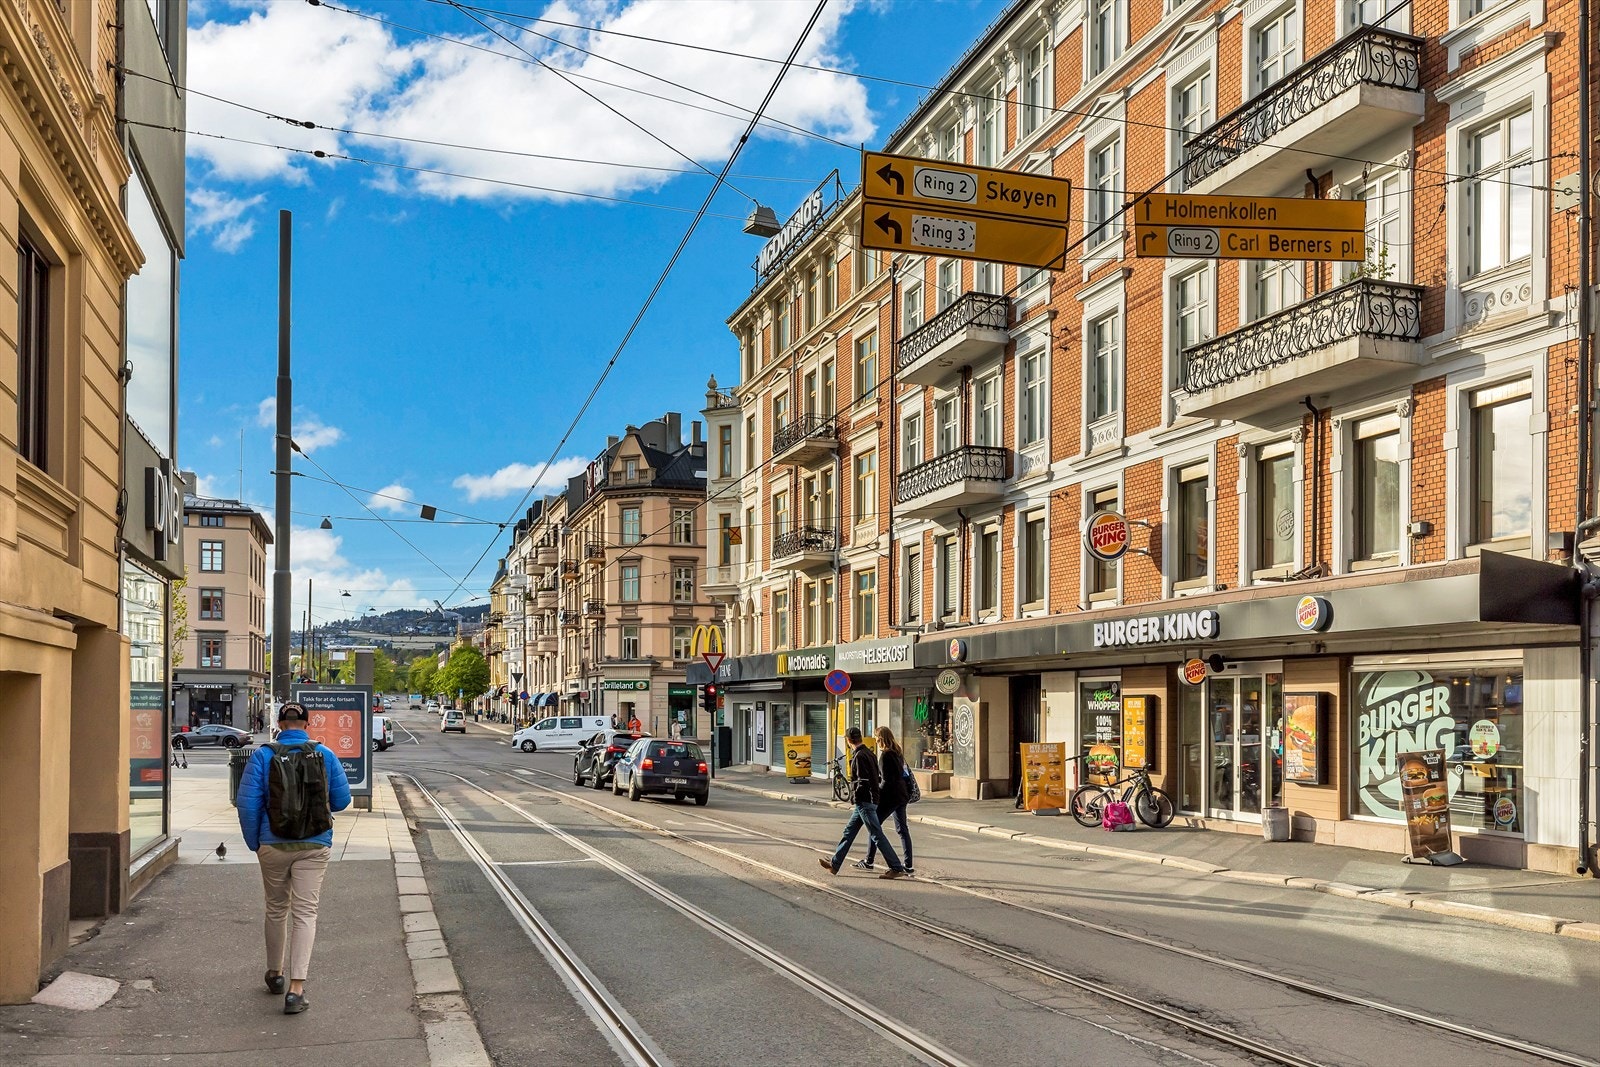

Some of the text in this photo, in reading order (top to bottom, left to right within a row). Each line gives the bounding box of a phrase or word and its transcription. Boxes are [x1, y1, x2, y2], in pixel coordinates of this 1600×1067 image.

[923, 175, 1057, 209] Ring 2 Skøyen
[1165, 200, 1277, 221] Holmenkollen
[922, 224, 966, 243] Ring 3
[1174, 233, 1358, 257] Ring 2 Carl Berners pl.
[152, 459, 179, 561] DNB
[1092, 521, 1125, 537] BURGER
[1093, 530, 1126, 550] KING
[1299, 602, 1316, 614] BURGER
[1300, 607, 1317, 622] KING
[1093, 609, 1212, 647] BURGER KING
[788, 654, 827, 672] McDonald's
[863, 645, 908, 664] HELSEKOST
[1186, 662, 1205, 673] BURGER
[1187, 667, 1206, 680] KING
[604, 682, 634, 690] brilleland
[1087, 701, 1120, 711] WHOPPER
[1096, 715, 1112, 726] 100%
[1359, 686, 1451, 746] BURGER
[1359, 716, 1456, 789] KING
